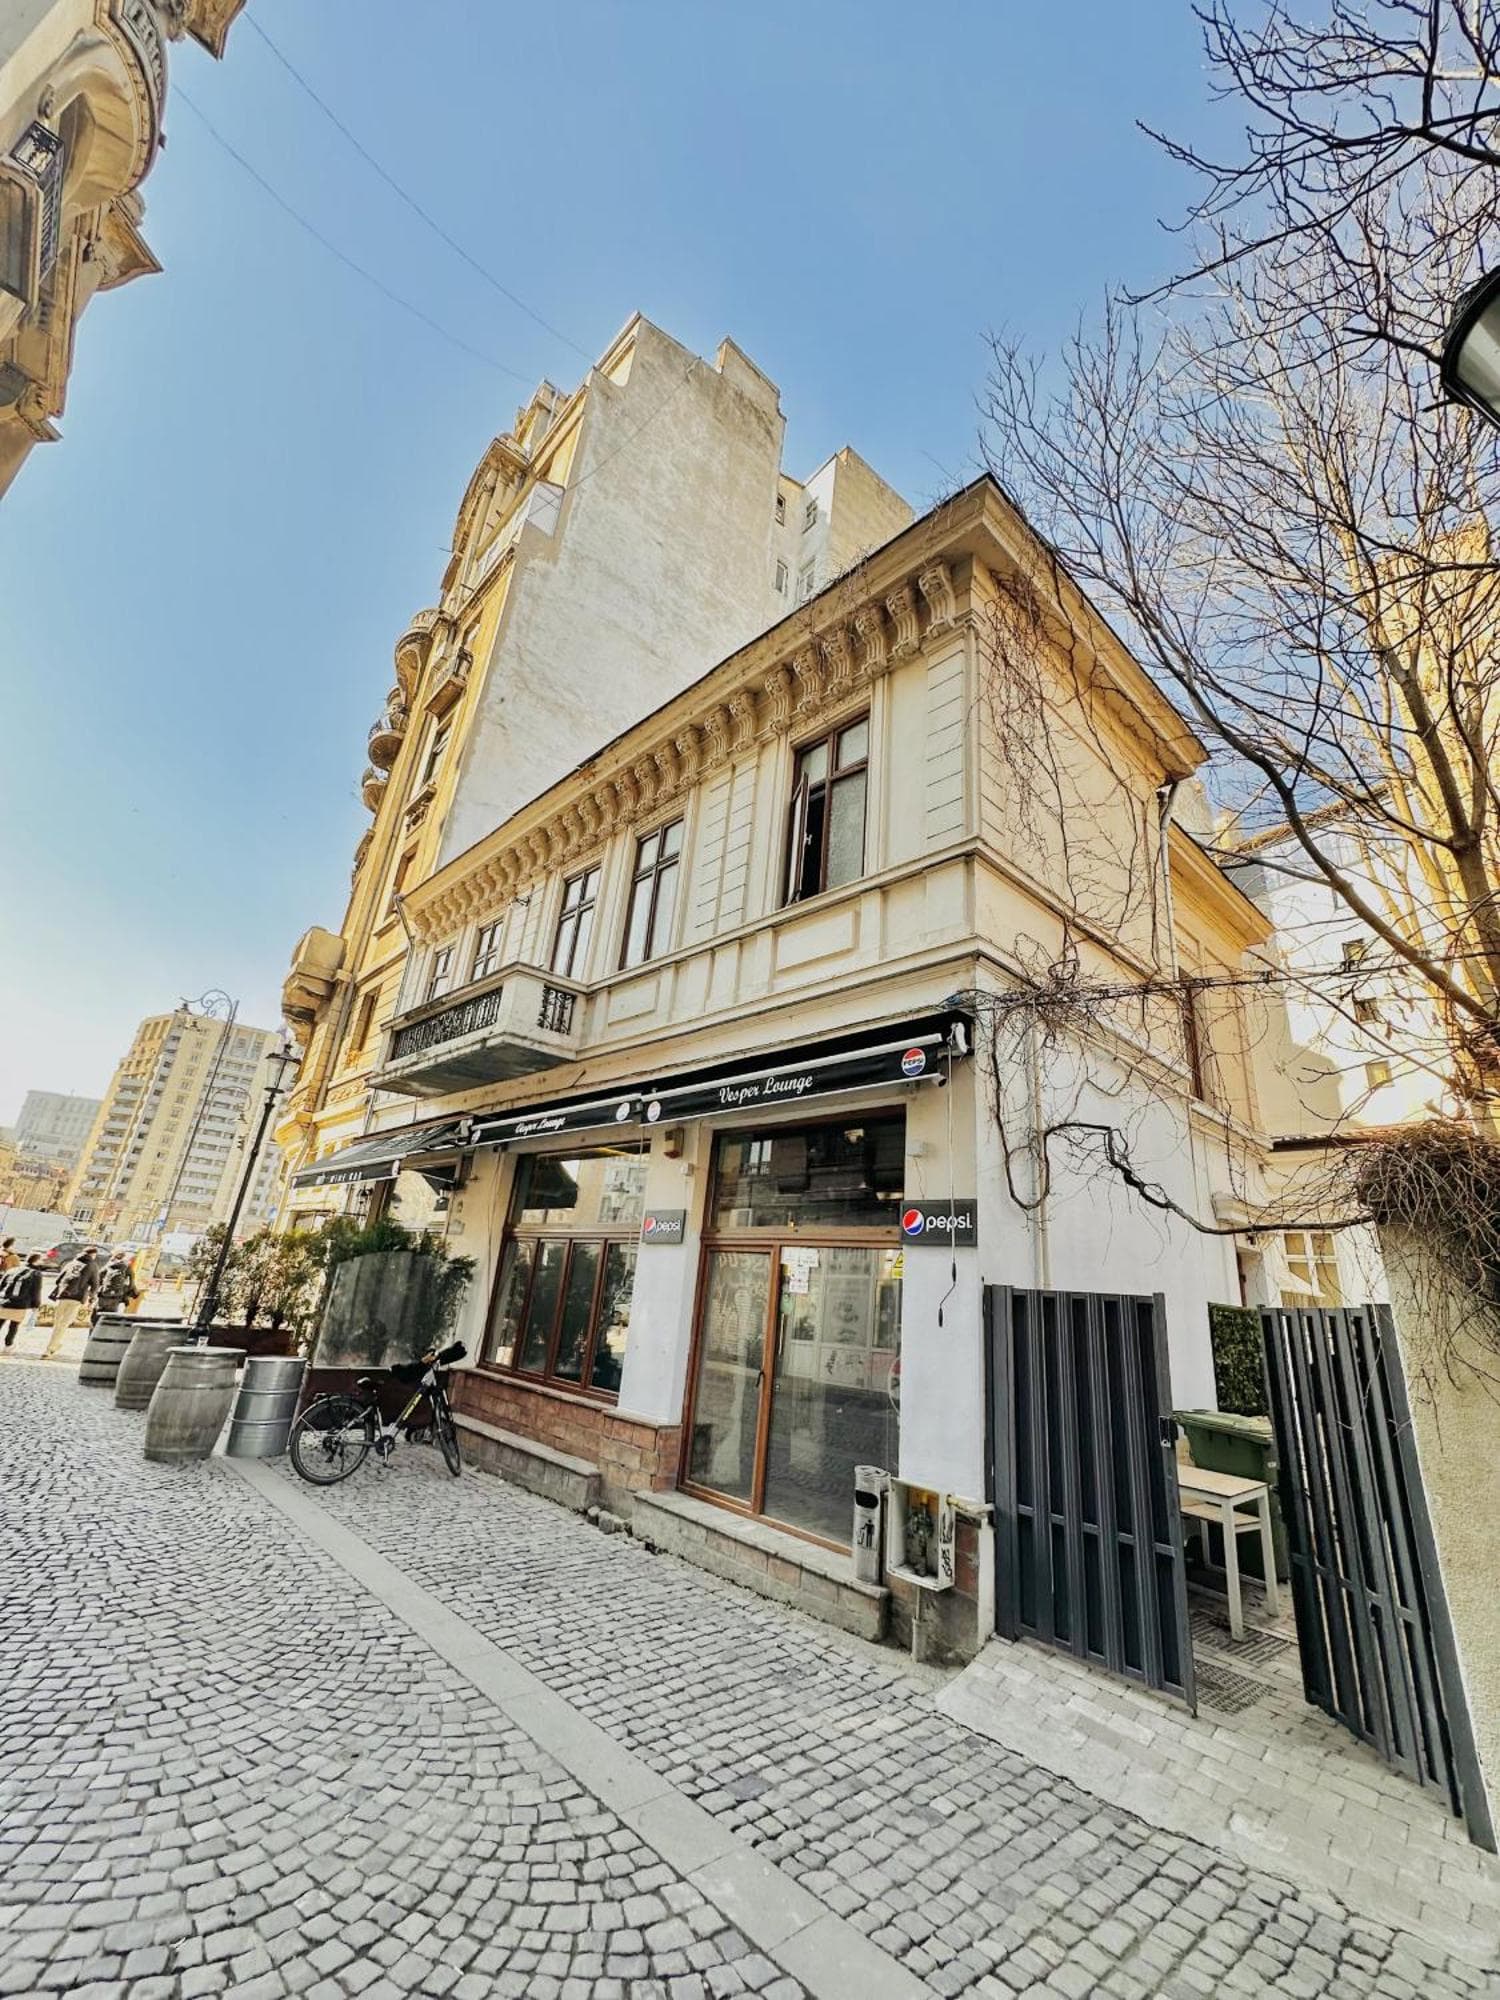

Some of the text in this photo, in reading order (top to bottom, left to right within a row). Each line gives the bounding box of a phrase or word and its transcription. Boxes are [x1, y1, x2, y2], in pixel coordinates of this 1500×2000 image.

[719, 1075, 813, 1105] Vesper Lounge
[656, 1218, 681, 1232] pepsi
[926, 1214, 973, 1233] pepsi
